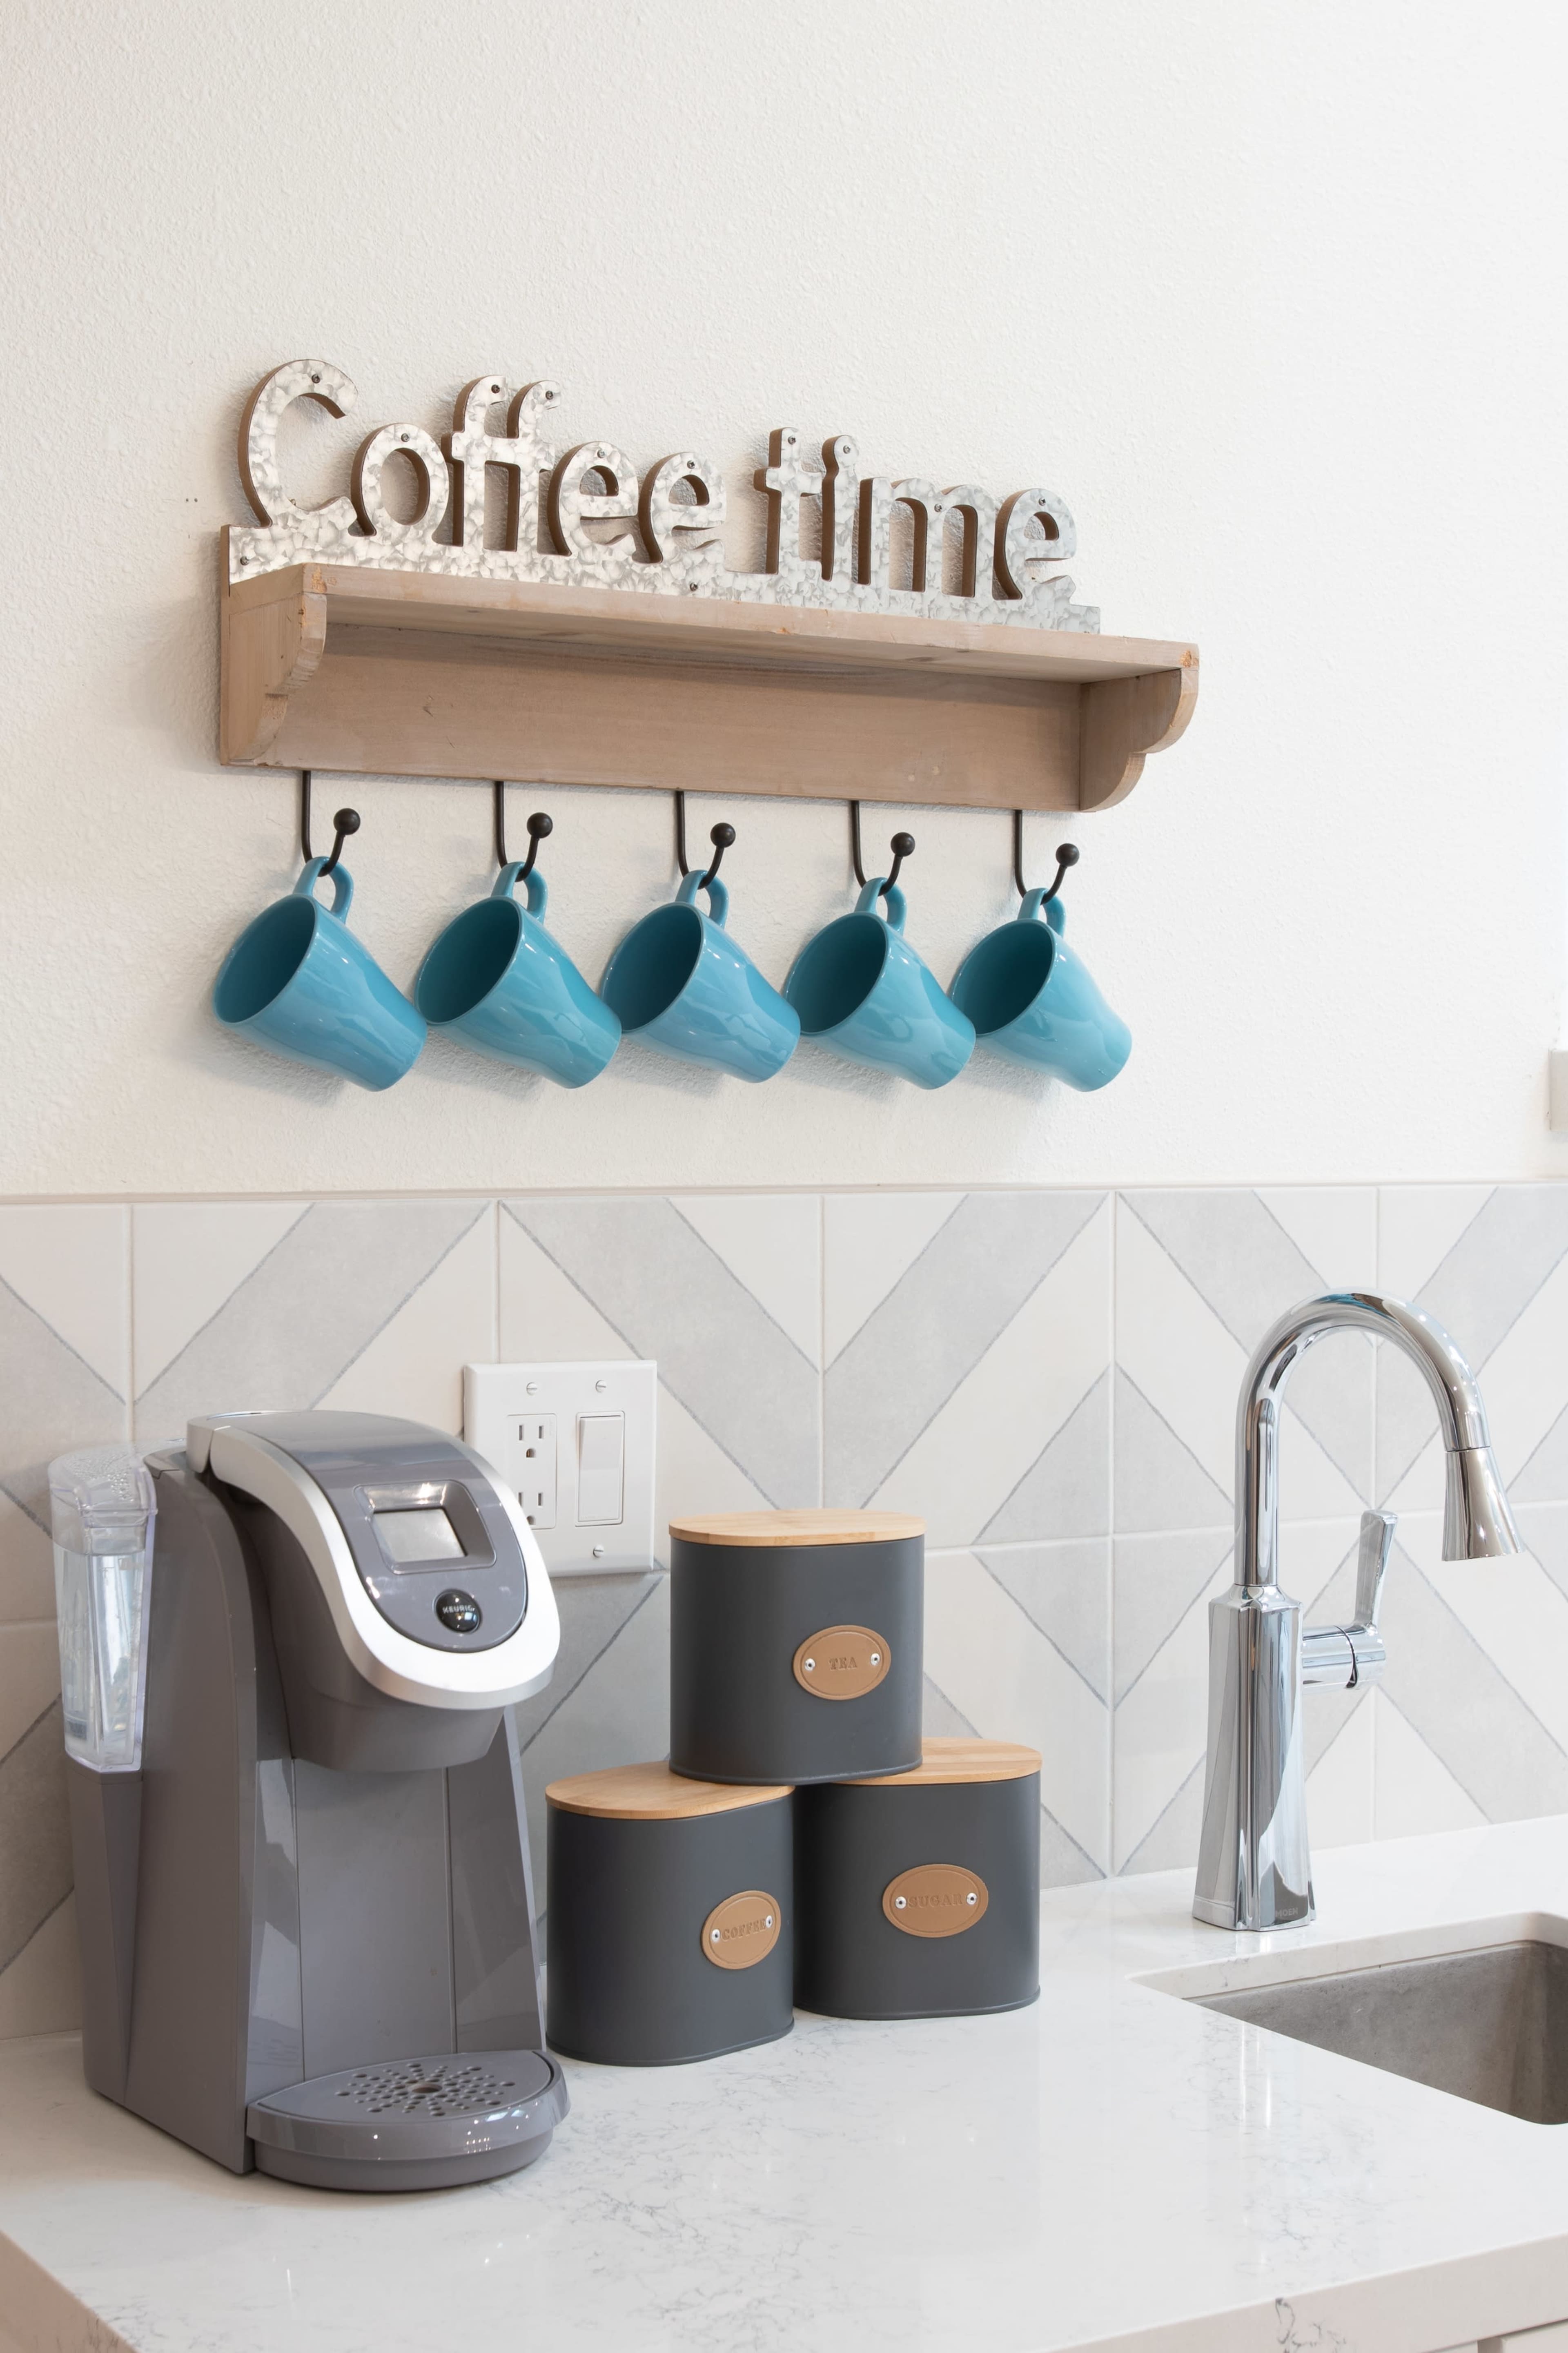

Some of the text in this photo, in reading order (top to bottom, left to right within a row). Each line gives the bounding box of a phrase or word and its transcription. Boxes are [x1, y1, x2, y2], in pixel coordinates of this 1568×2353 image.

[238, 359, 1077, 602] Coffee time
[442, 1604, 475, 1614] KEURIG
[829, 1656, 857, 1671] TEA
[907, 1893, 963, 1908] SUGAR
[1275, 1907, 1298, 1917] MOEN
[722, 1918, 766, 1942] COFFEE
